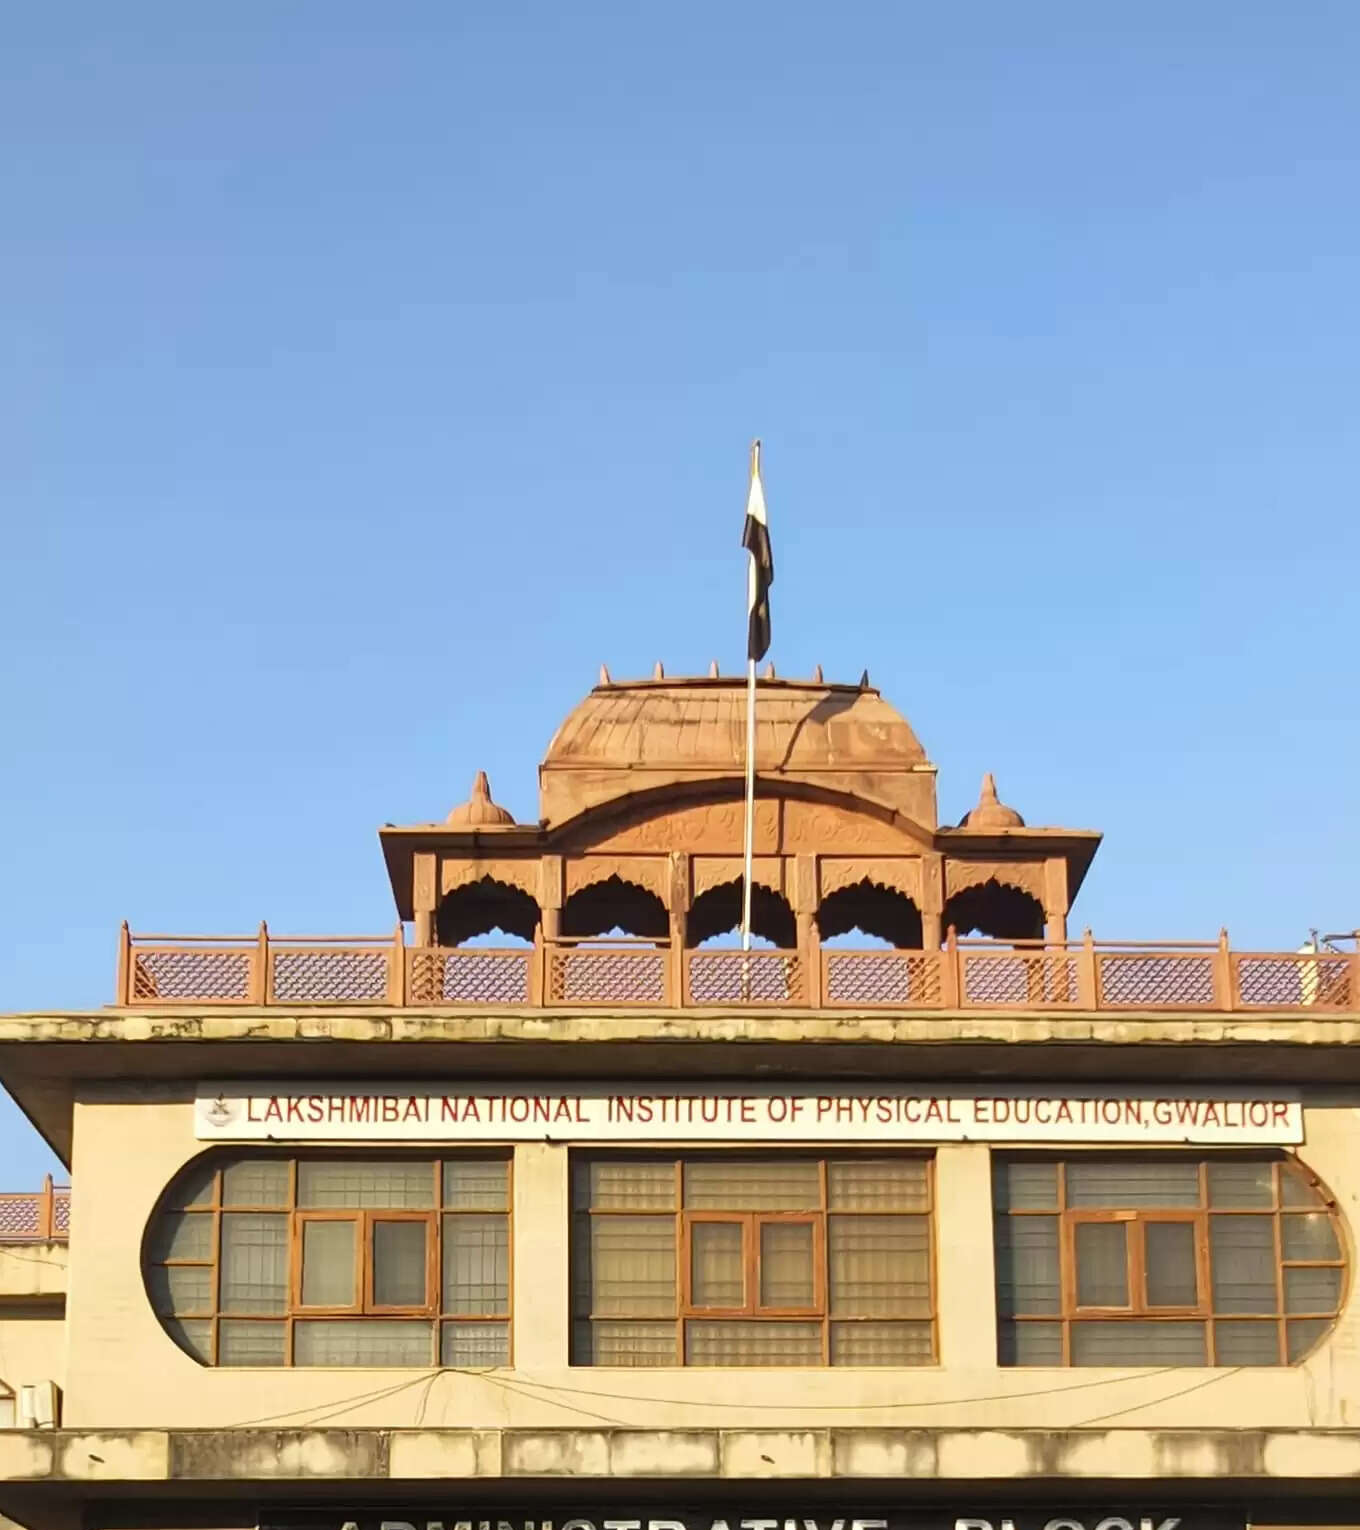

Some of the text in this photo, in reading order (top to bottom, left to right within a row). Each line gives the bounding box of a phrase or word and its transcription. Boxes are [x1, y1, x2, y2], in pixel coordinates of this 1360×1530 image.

[247, 1096, 429, 1123] LAKSHMIBAI
[441, 1096, 591, 1123] NATIONAL
[607, 1096, 756, 1123] INSTITUTE
[767, 1096, 804, 1122] OF
[817, 1097, 961, 1123] PHYSICAL
